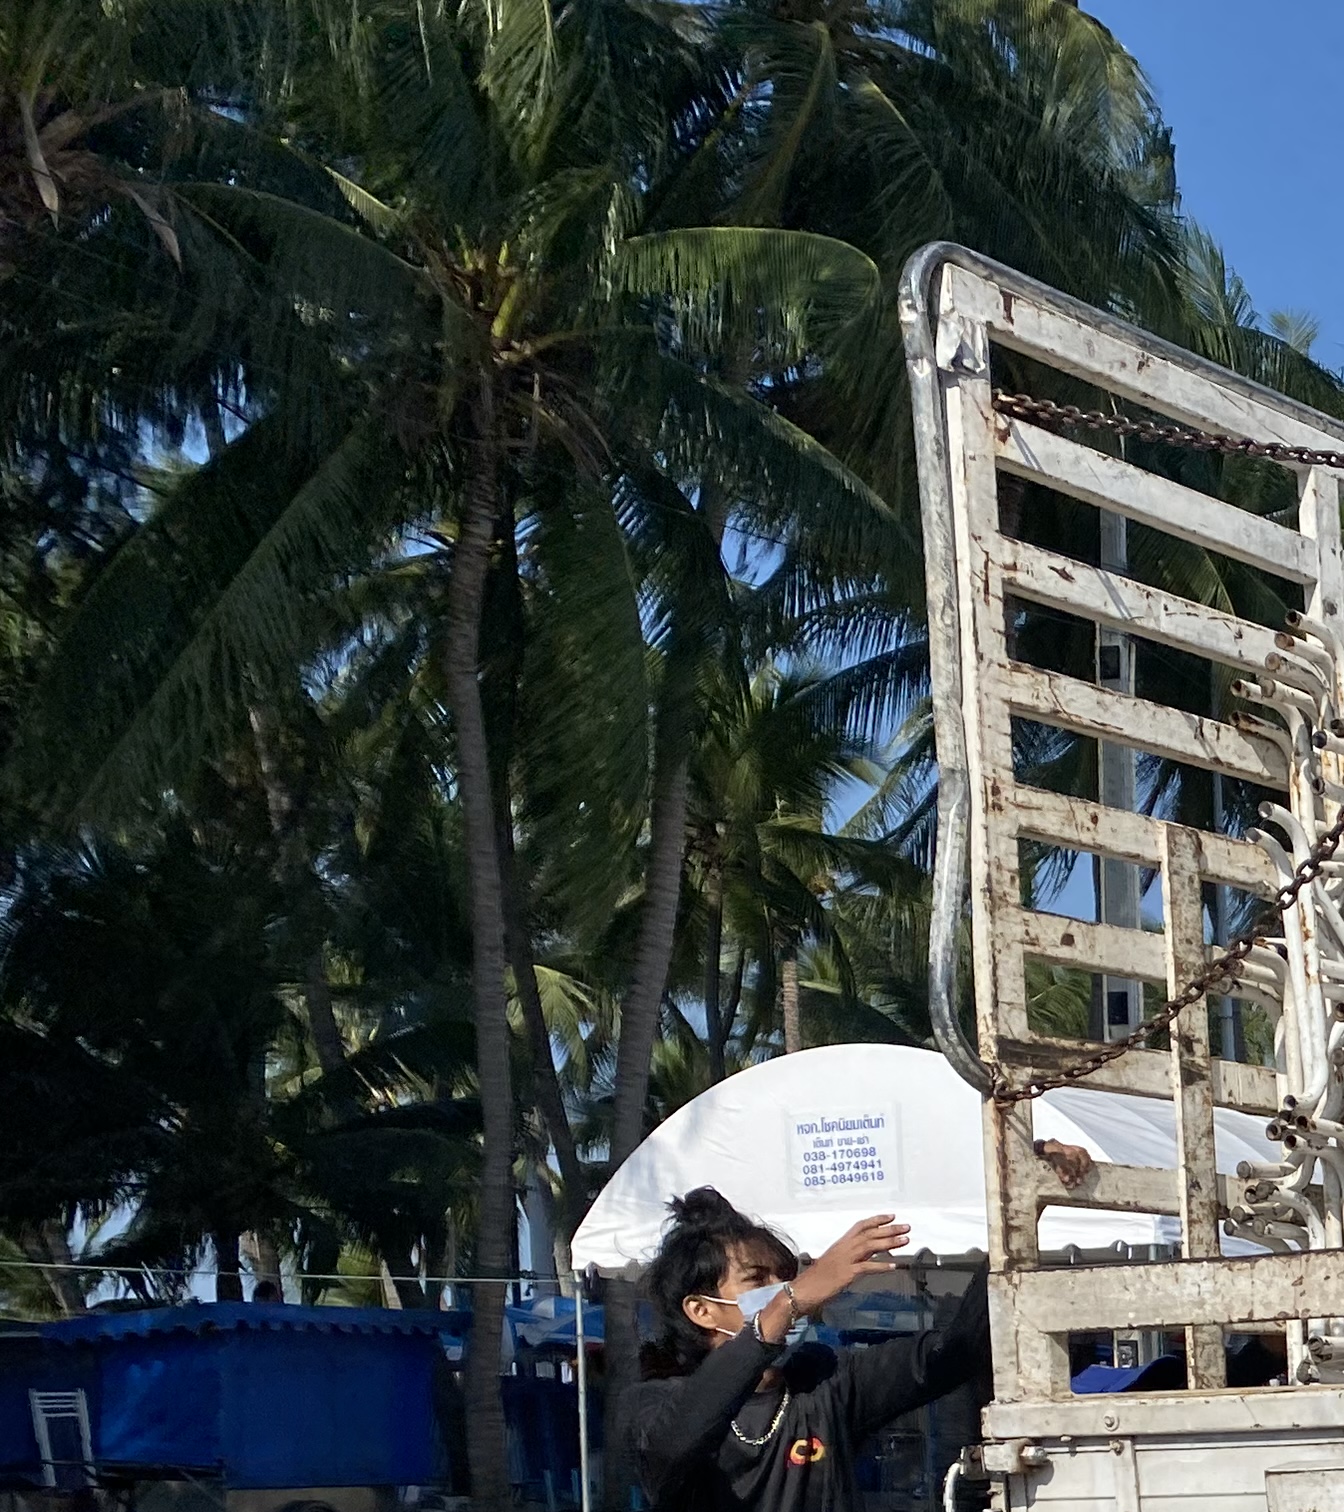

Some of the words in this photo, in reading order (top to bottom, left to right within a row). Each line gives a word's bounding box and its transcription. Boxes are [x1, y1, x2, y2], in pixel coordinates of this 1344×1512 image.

[803, 1146, 876, 1162] 038-170698
[802, 1159, 882, 1175] 081-4974941
[804, 1170, 884, 1187] 085-0849618
